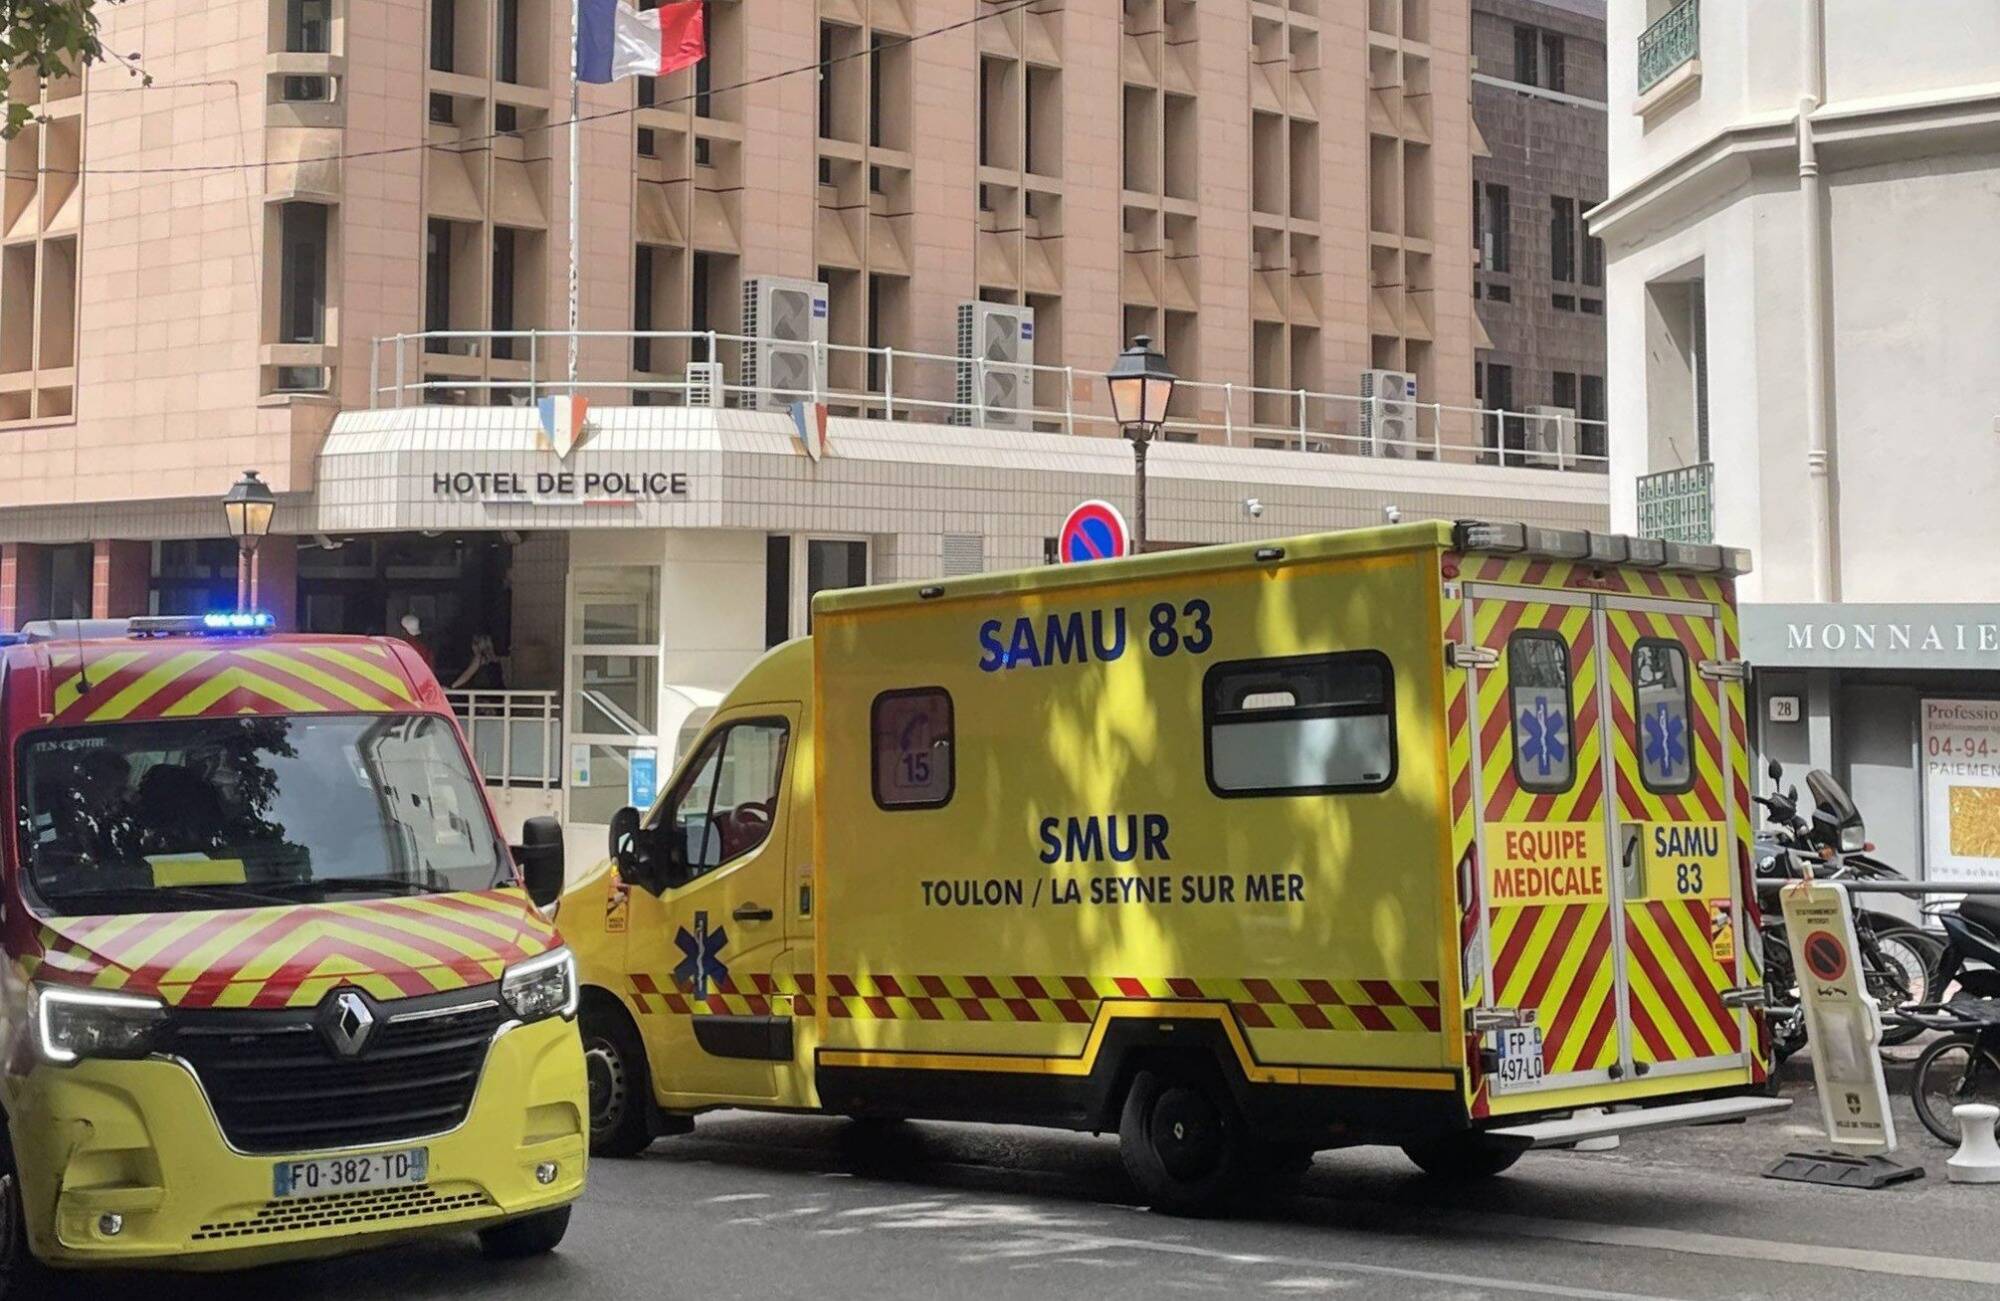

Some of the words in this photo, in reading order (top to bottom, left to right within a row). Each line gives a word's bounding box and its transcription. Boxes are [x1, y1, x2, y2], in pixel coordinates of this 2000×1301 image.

[433, 472, 526, 494] HOTEL
[537, 472, 574, 494] DE
[584, 472, 687, 494] POLICE
[978, 607, 1126, 673] SAMU
[1149, 598, 1213, 657] 83
[1787, 623, 2000, 650] MONNAIE
[1777, 702, 1792, 716] 28
[903, 752, 930, 783] 15
[1039, 813, 1170, 864] SMUR
[1506, 830, 1587, 863] EQUIPE
[1655, 826, 1718, 858] SAMU
[921, 879, 1022, 906] TOULON
[1031, 878, 1043, 908] /
[1051, 878, 1082, 904] LA
[1090, 876, 1172, 903] SEYNE
[1181, 874, 1235, 902] SUR
[1245, 873, 1305, 902] MER
[1494, 866, 1603, 898] MEDICALE
[1676, 863, 1703, 894] 83
